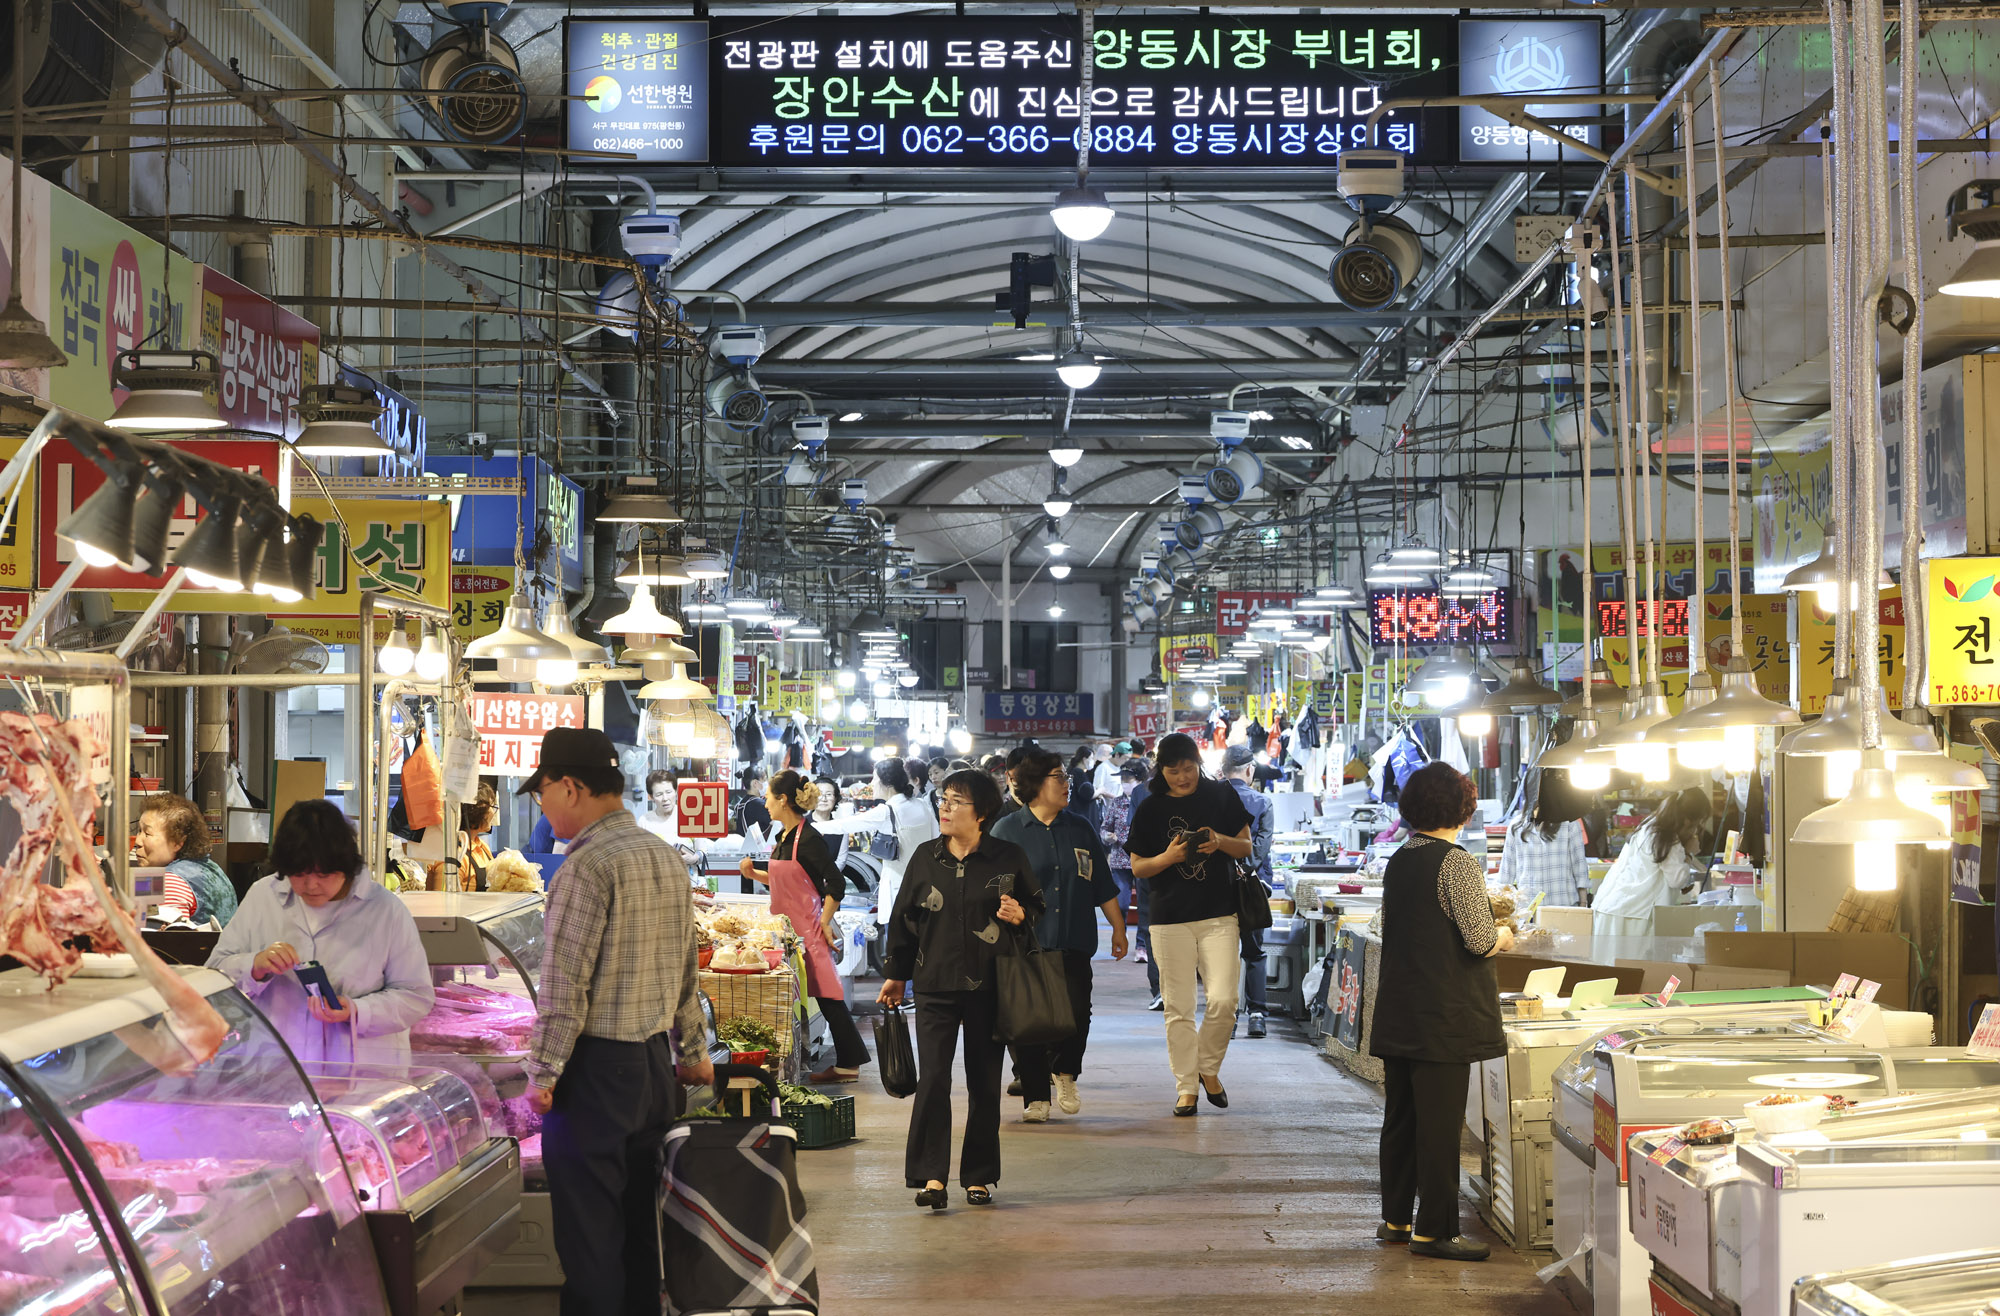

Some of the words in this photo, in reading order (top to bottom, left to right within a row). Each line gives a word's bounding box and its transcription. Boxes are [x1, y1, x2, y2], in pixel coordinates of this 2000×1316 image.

[601, 53, 678, 71] 건강검진
[724, 40, 820, 69] 전광판
[834, 40, 928, 69] 설치에
[944, 40, 1072, 69] 도움주신
[1093, 29, 1271, 69] 양동시장
[1291, 29, 1441, 71] 부녀회,
[627, 84, 693, 104] 선한병원
[772, 76, 999, 119] 장안수산에
[1017, 86, 1156, 118] 진심으로
[1172, 86, 1395, 118] 감사드립니다.
[593, 138, 684, 150] 062)466-1000
[749, 124, 885, 154] 후원문의
[902, 125, 1157, 153] 062-366-0884
[1171, 123, 1415, 155] 양동시장상인회
[61, 246, 101, 368] 잡곡
[680, 787, 725, 834] 오리
